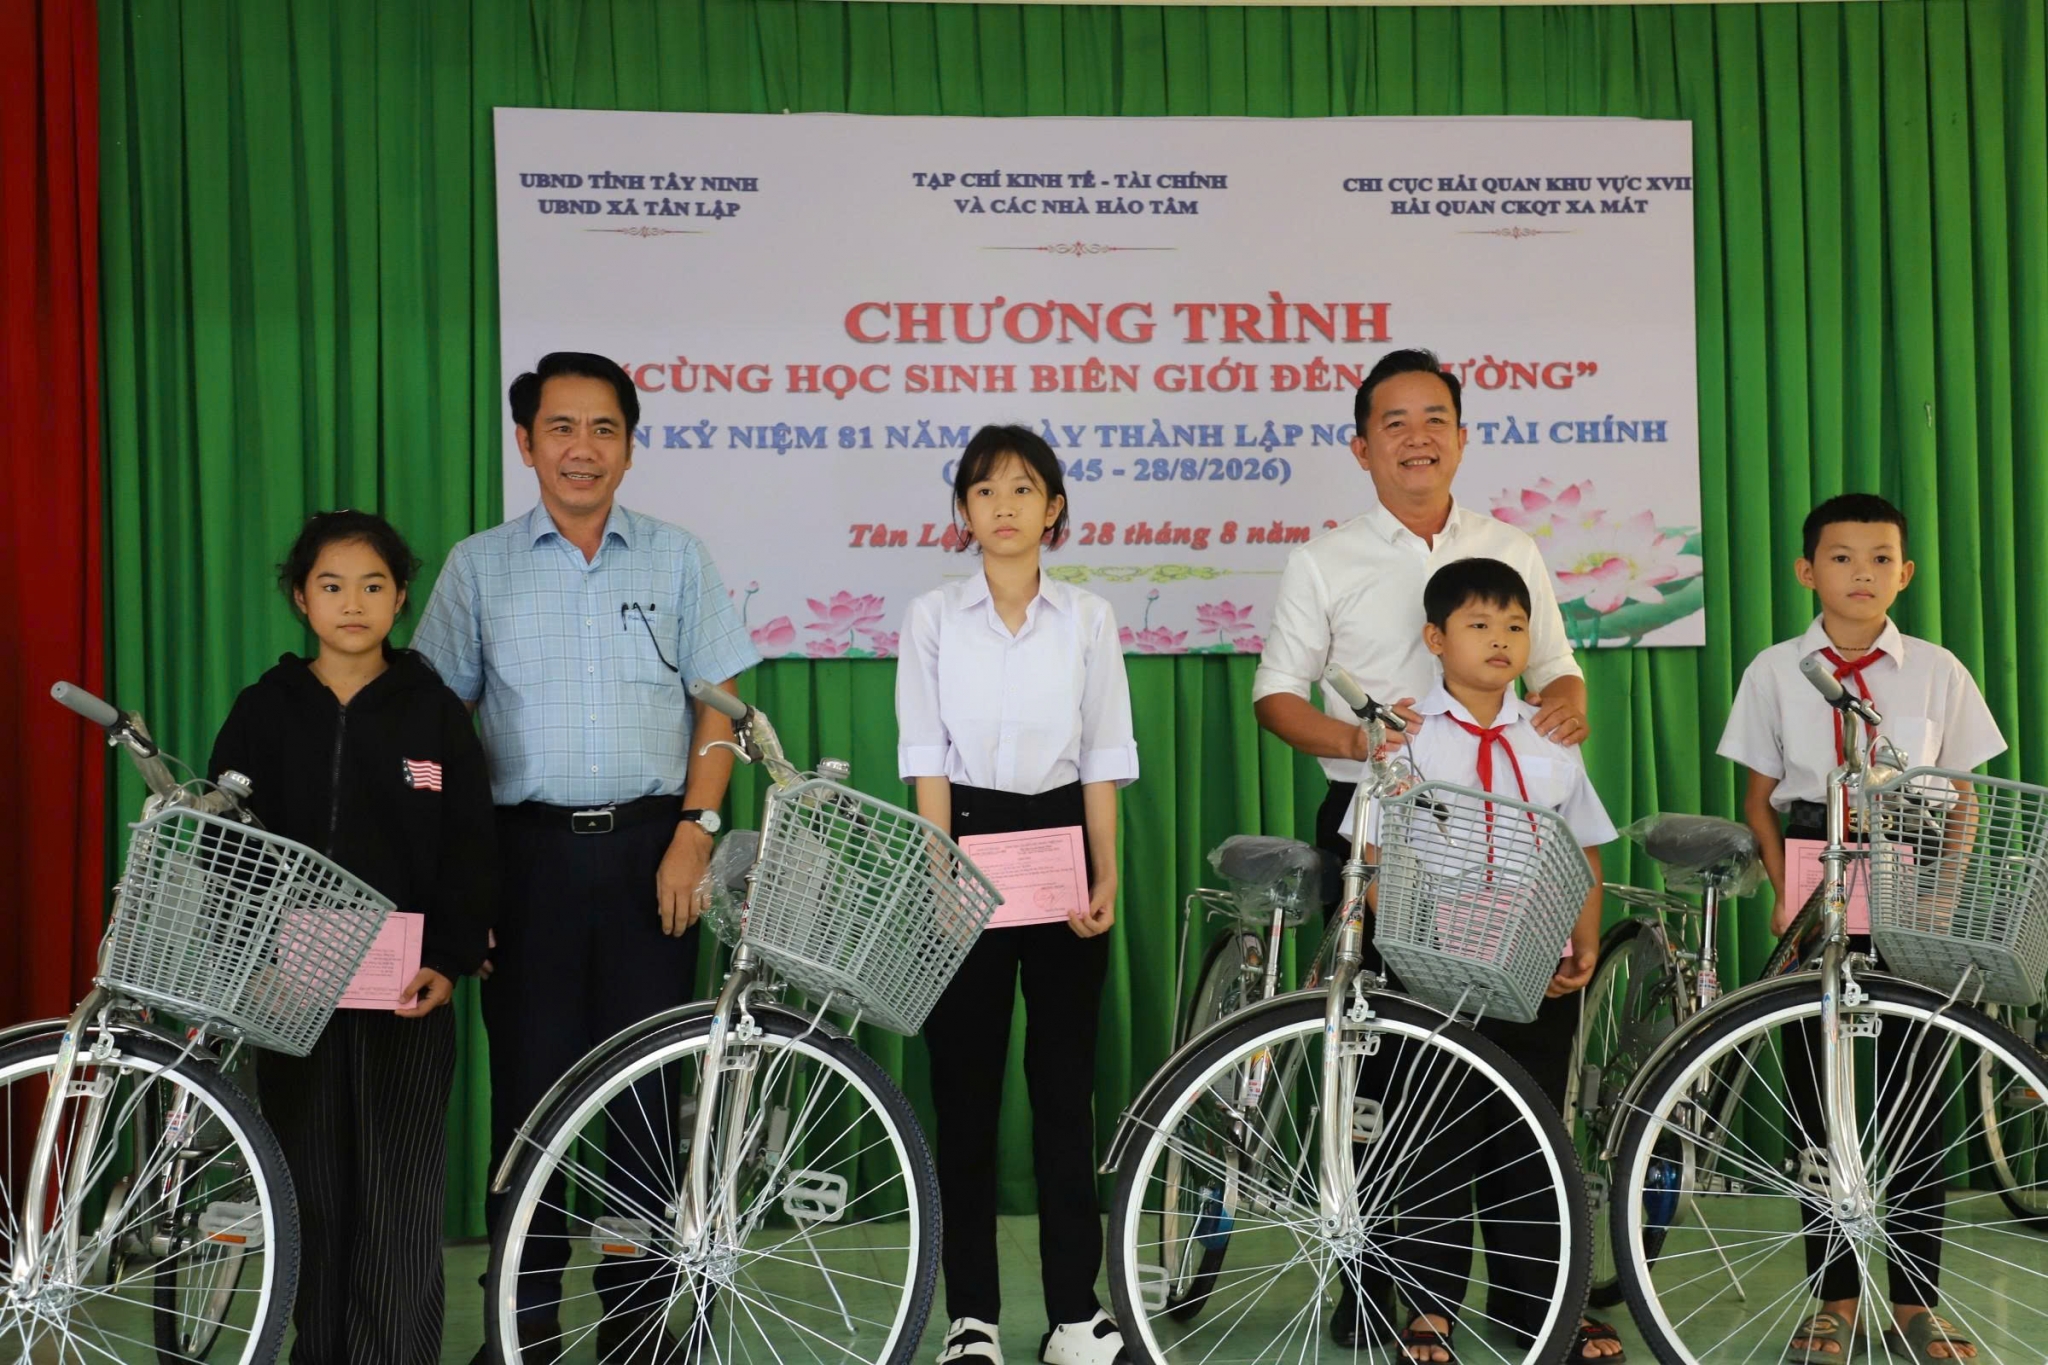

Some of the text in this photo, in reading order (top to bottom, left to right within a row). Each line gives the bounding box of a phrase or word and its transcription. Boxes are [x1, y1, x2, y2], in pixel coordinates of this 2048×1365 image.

[518, 170, 760, 193] UBND TỈNH TÂY NINH
[911, 172, 957, 192] TẠP
[959, 168, 1002, 188] CHÍ
[1005, 172, 1064, 189] KINH
[1113, 170, 1152, 189] TÀI
[1155, 170, 1229, 190] CHÍNH
[1342, 173, 1693, 196] CHI CỤC HẢI QUAN KHU VỰC XVII
[537, 197, 742, 221] UBND XÃ TÂN LẬP
[953, 195, 1199, 215] VÀ CÁC NHÀ HẢO TÂM
[1390, 196, 1431, 215] HẢI
[1434, 199, 1496, 218] QUAN
[1500, 199, 1562, 217] CKQT
[1564, 199, 1597, 215] XA
[843, 290, 1393, 345] CHƯƠNG TRÌNH
[622, 354, 1599, 401] CÙNG HỌC SINH BIÊN GIỚI ĐẾN ƯỜNG”
[662, 418, 719, 450] KỶ
[727, 421, 829, 456] NIỆM
[837, 425, 874, 450] 81
[884, 419, 971, 448] NĂM
[1093, 418, 1223, 449] THÀNH
[1233, 419, 1304, 454] LẬP
[1476, 415, 1540, 445] TÀI
[1548, 413, 1669, 445] CHÍNH
[1133, 457, 1292, 486] 28/8/2026)
[848, 522, 909, 549] Tân
[1077, 521, 1117, 547] 28
[1123, 520, 1212, 551] tháng
[1219, 520, 1239, 545] 8
[1245, 520, 1311, 545] năm
